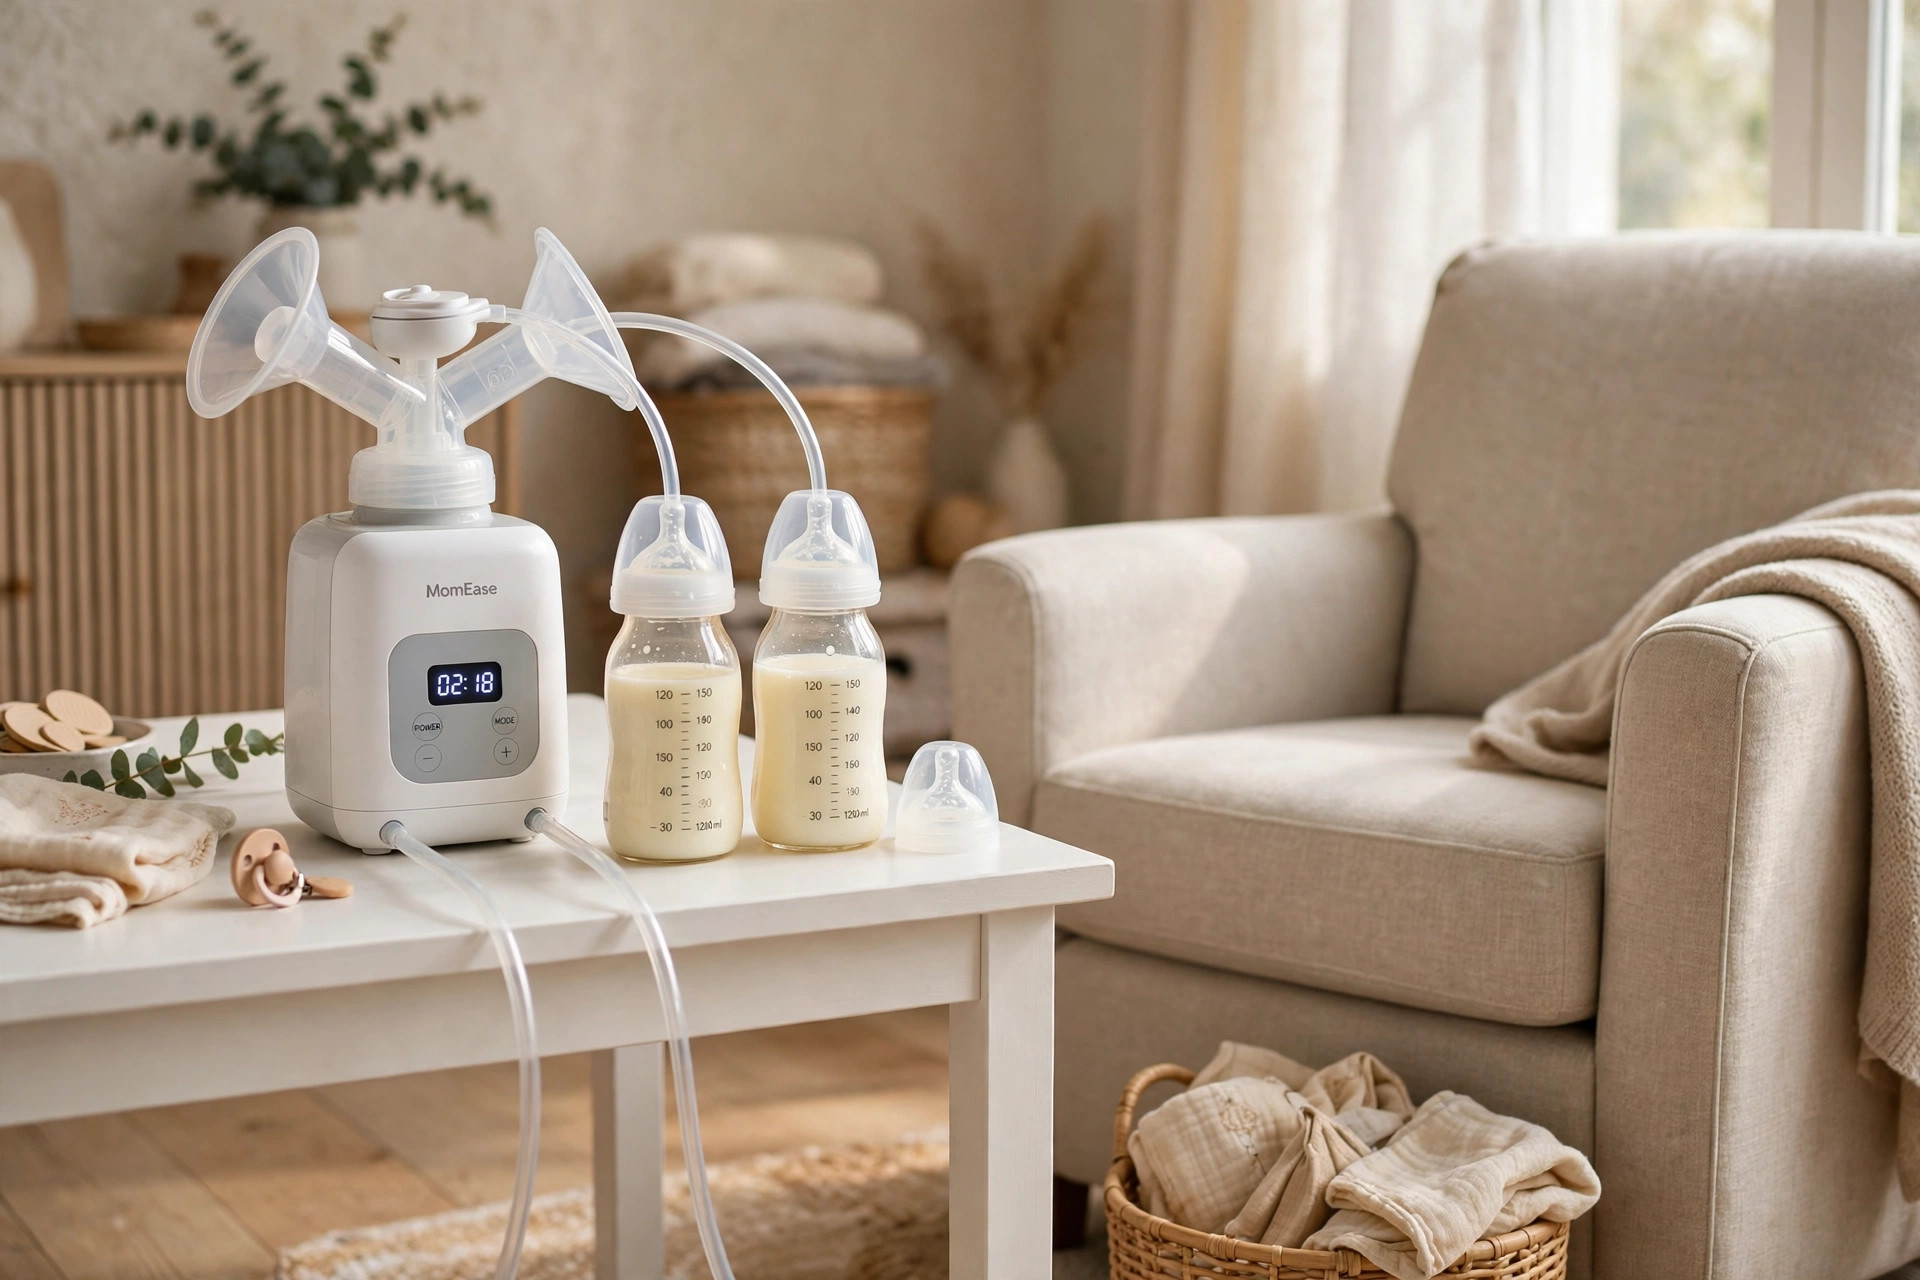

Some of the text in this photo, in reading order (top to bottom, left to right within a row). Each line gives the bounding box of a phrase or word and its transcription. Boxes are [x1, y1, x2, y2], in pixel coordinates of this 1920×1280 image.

[426, 582, 498, 598] MomEase
[437, 671, 494, 697] 02:18
[804, 681, 823, 691] 120
[845, 679, 861, 689] 150
[655, 690, 673, 700] 120
[696, 688, 712, 698] 150
[805, 709, 823, 719] 100
[495, 716, 515, 725] MODE
[655, 719, 673, 729] 100
[414, 722, 441, 732] POWER
[845, 732, 860, 742] 120
[696, 742, 712, 752] 120
[808, 775, 822, 786] 40
[659, 787, 673, 797] 40
[809, 811, 822, 821] 30
